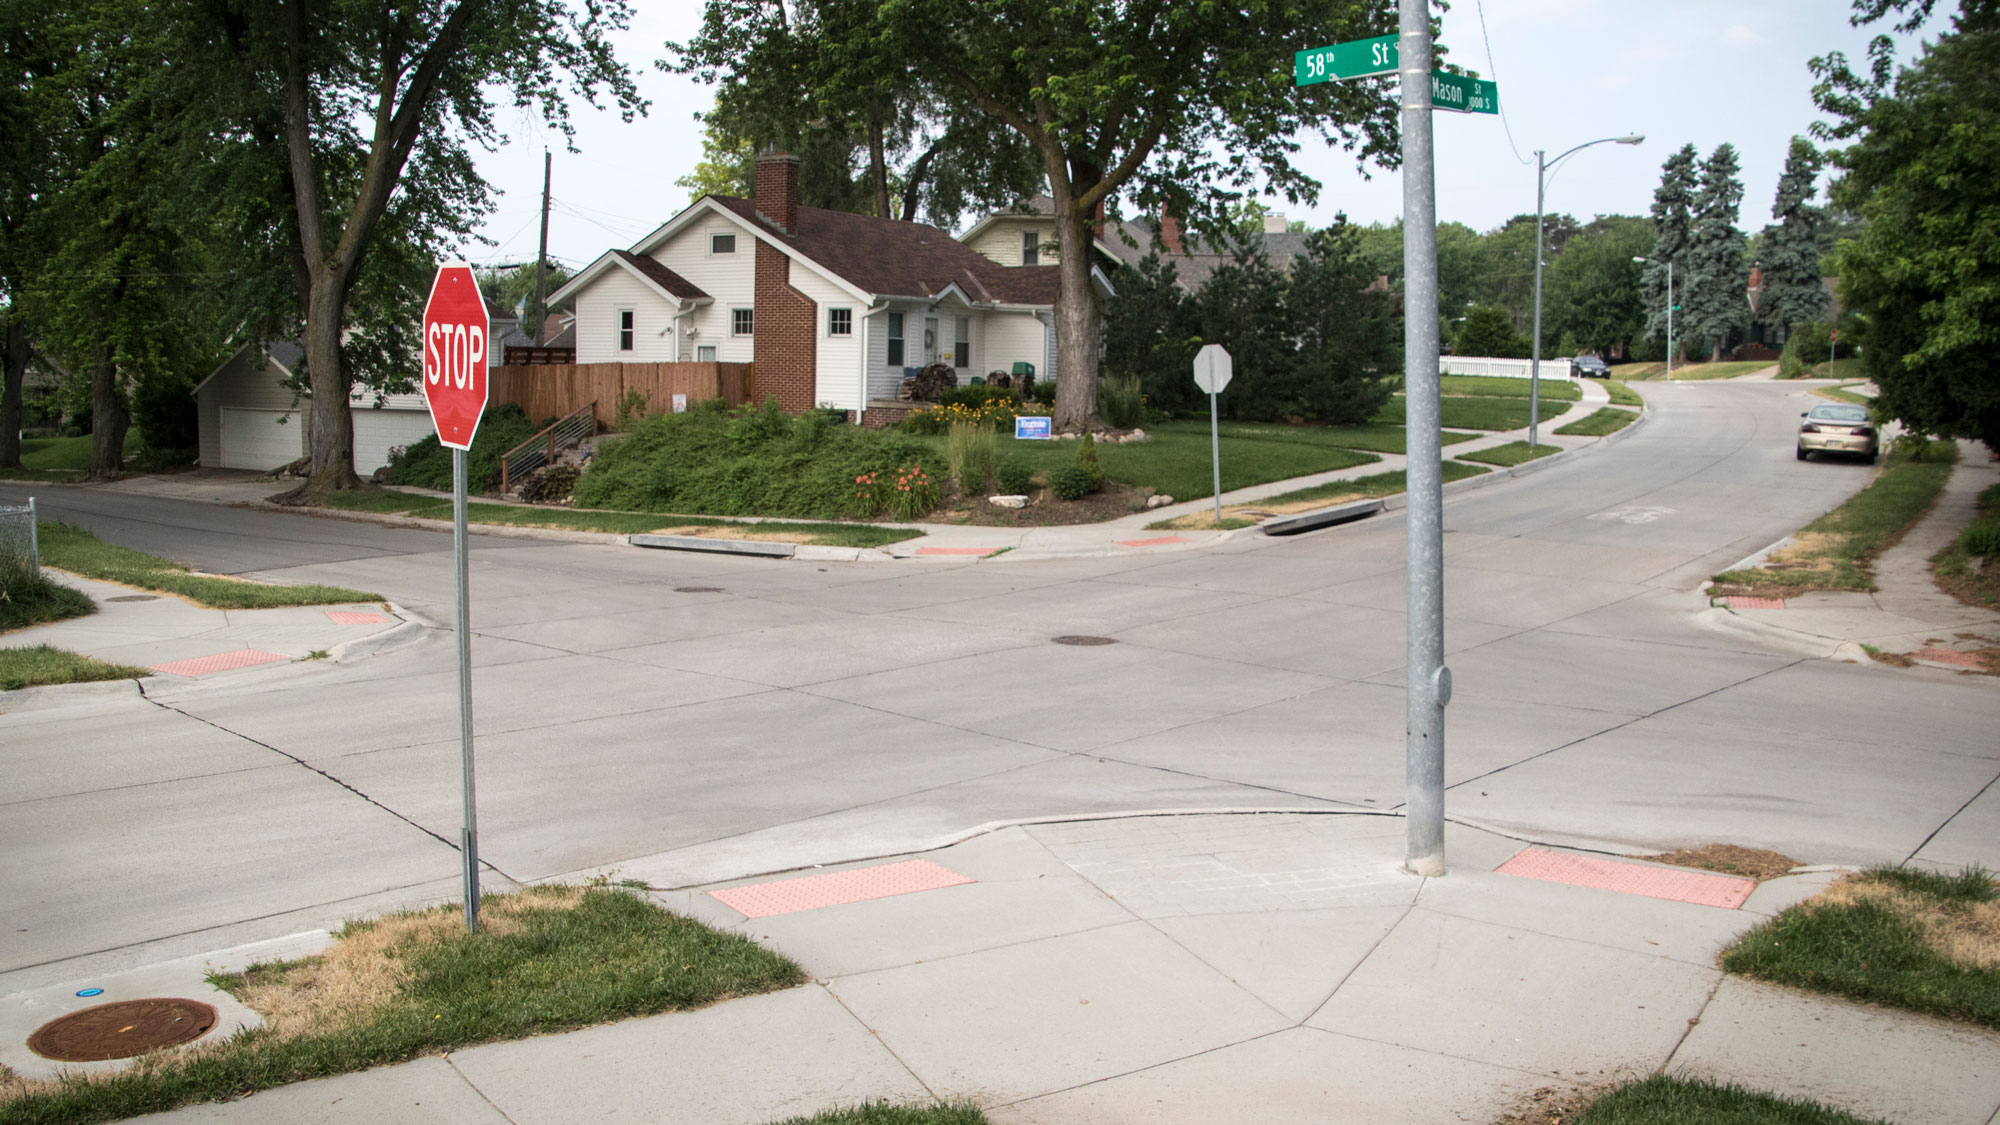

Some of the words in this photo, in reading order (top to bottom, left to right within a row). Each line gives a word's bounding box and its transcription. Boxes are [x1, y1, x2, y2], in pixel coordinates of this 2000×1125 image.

[1306, 51, 1335, 78] 58th
[1372, 42, 1389, 66] St
[1432, 76, 1463, 104] Mason
[1474, 83, 1482, 95] St
[1485, 97, 1491, 110] S
[427, 321, 484, 390] STOP
